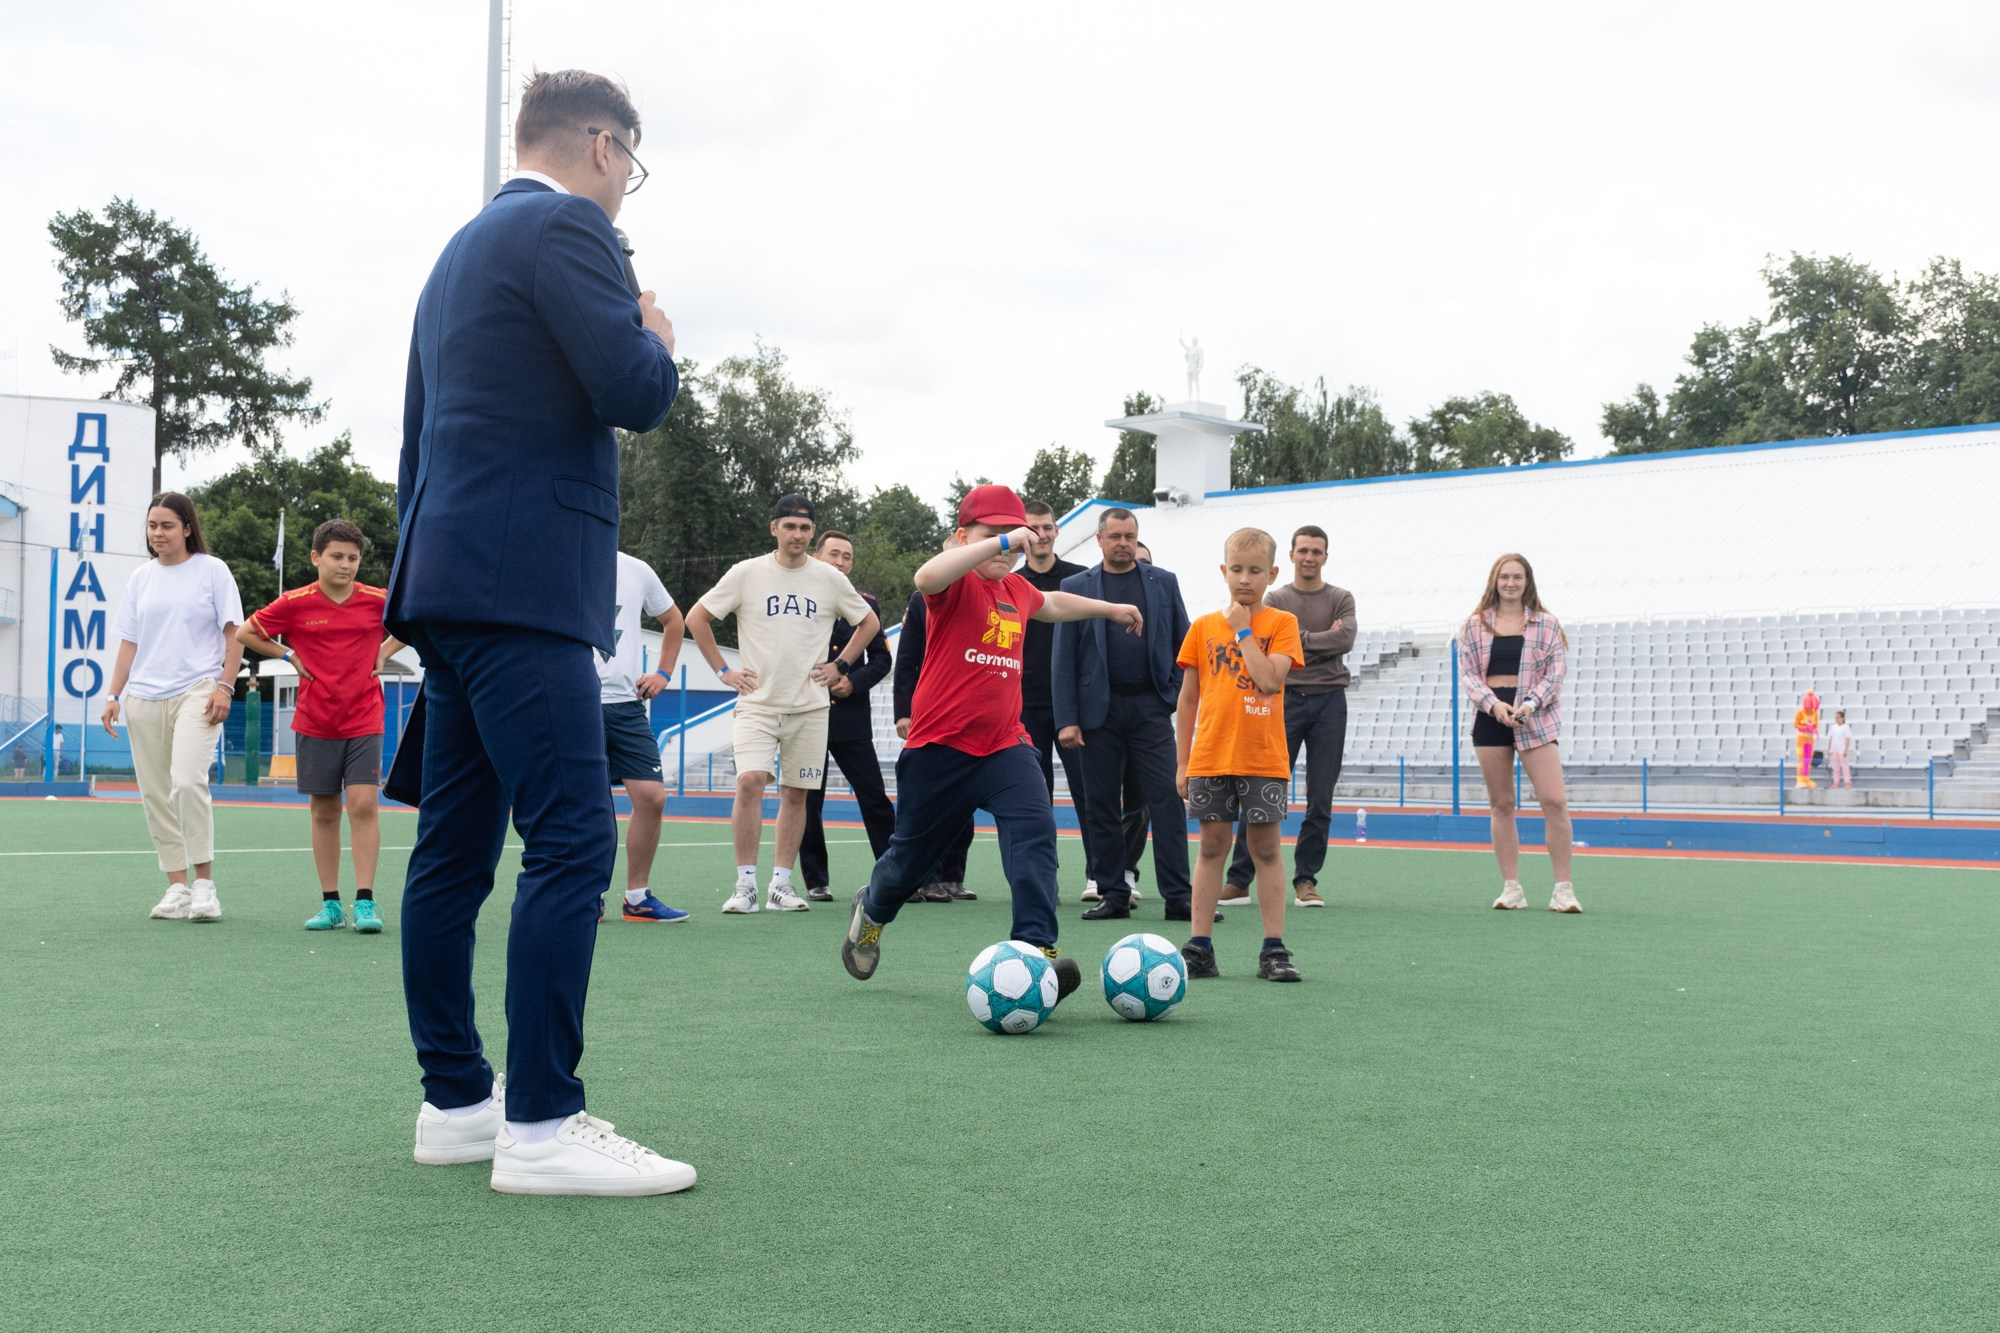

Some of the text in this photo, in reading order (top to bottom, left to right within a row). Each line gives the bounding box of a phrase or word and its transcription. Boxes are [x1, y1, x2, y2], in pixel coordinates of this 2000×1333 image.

[63, 412, 110, 698] ДИНАМО
[766, 594, 817, 619] GAP
[1243, 696, 1256, 704] NO
[799, 767, 822, 779] GAP
